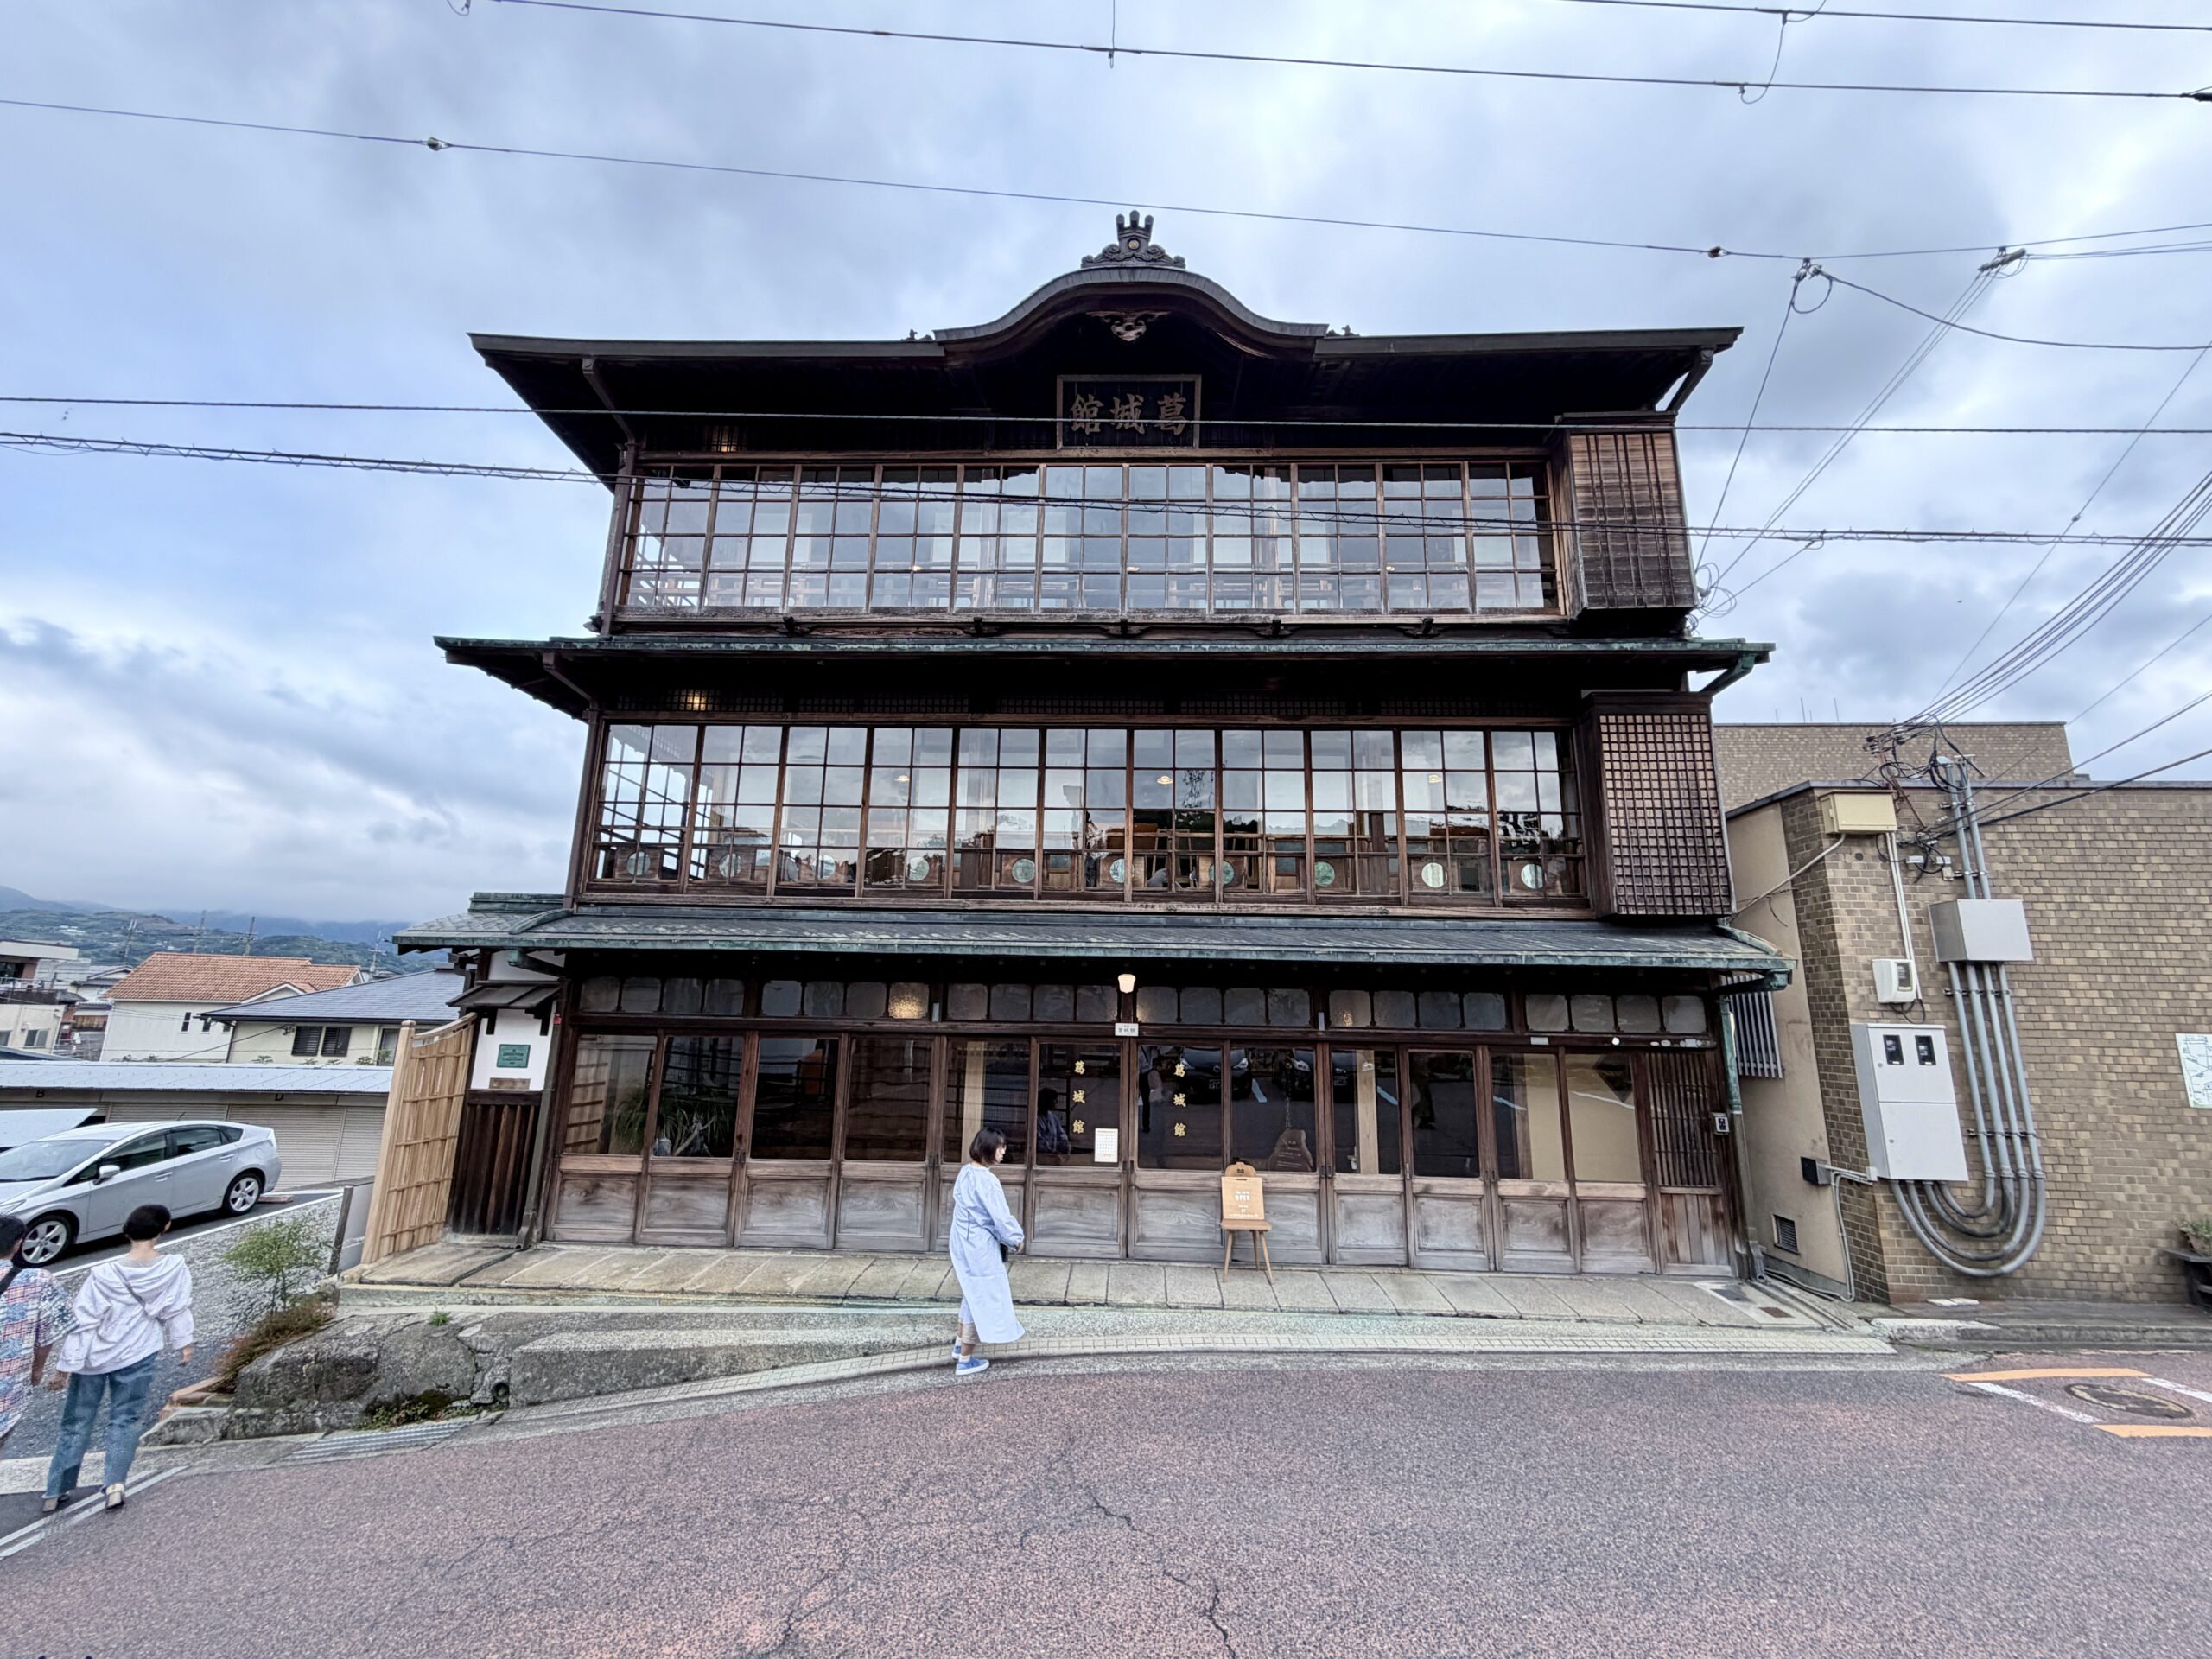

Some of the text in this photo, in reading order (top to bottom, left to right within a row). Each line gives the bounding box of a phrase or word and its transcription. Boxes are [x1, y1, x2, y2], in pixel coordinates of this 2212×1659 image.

[1072, 1060, 1085, 1134] 葛城館
[1173, 1063, 1186, 1137] 葛城館
